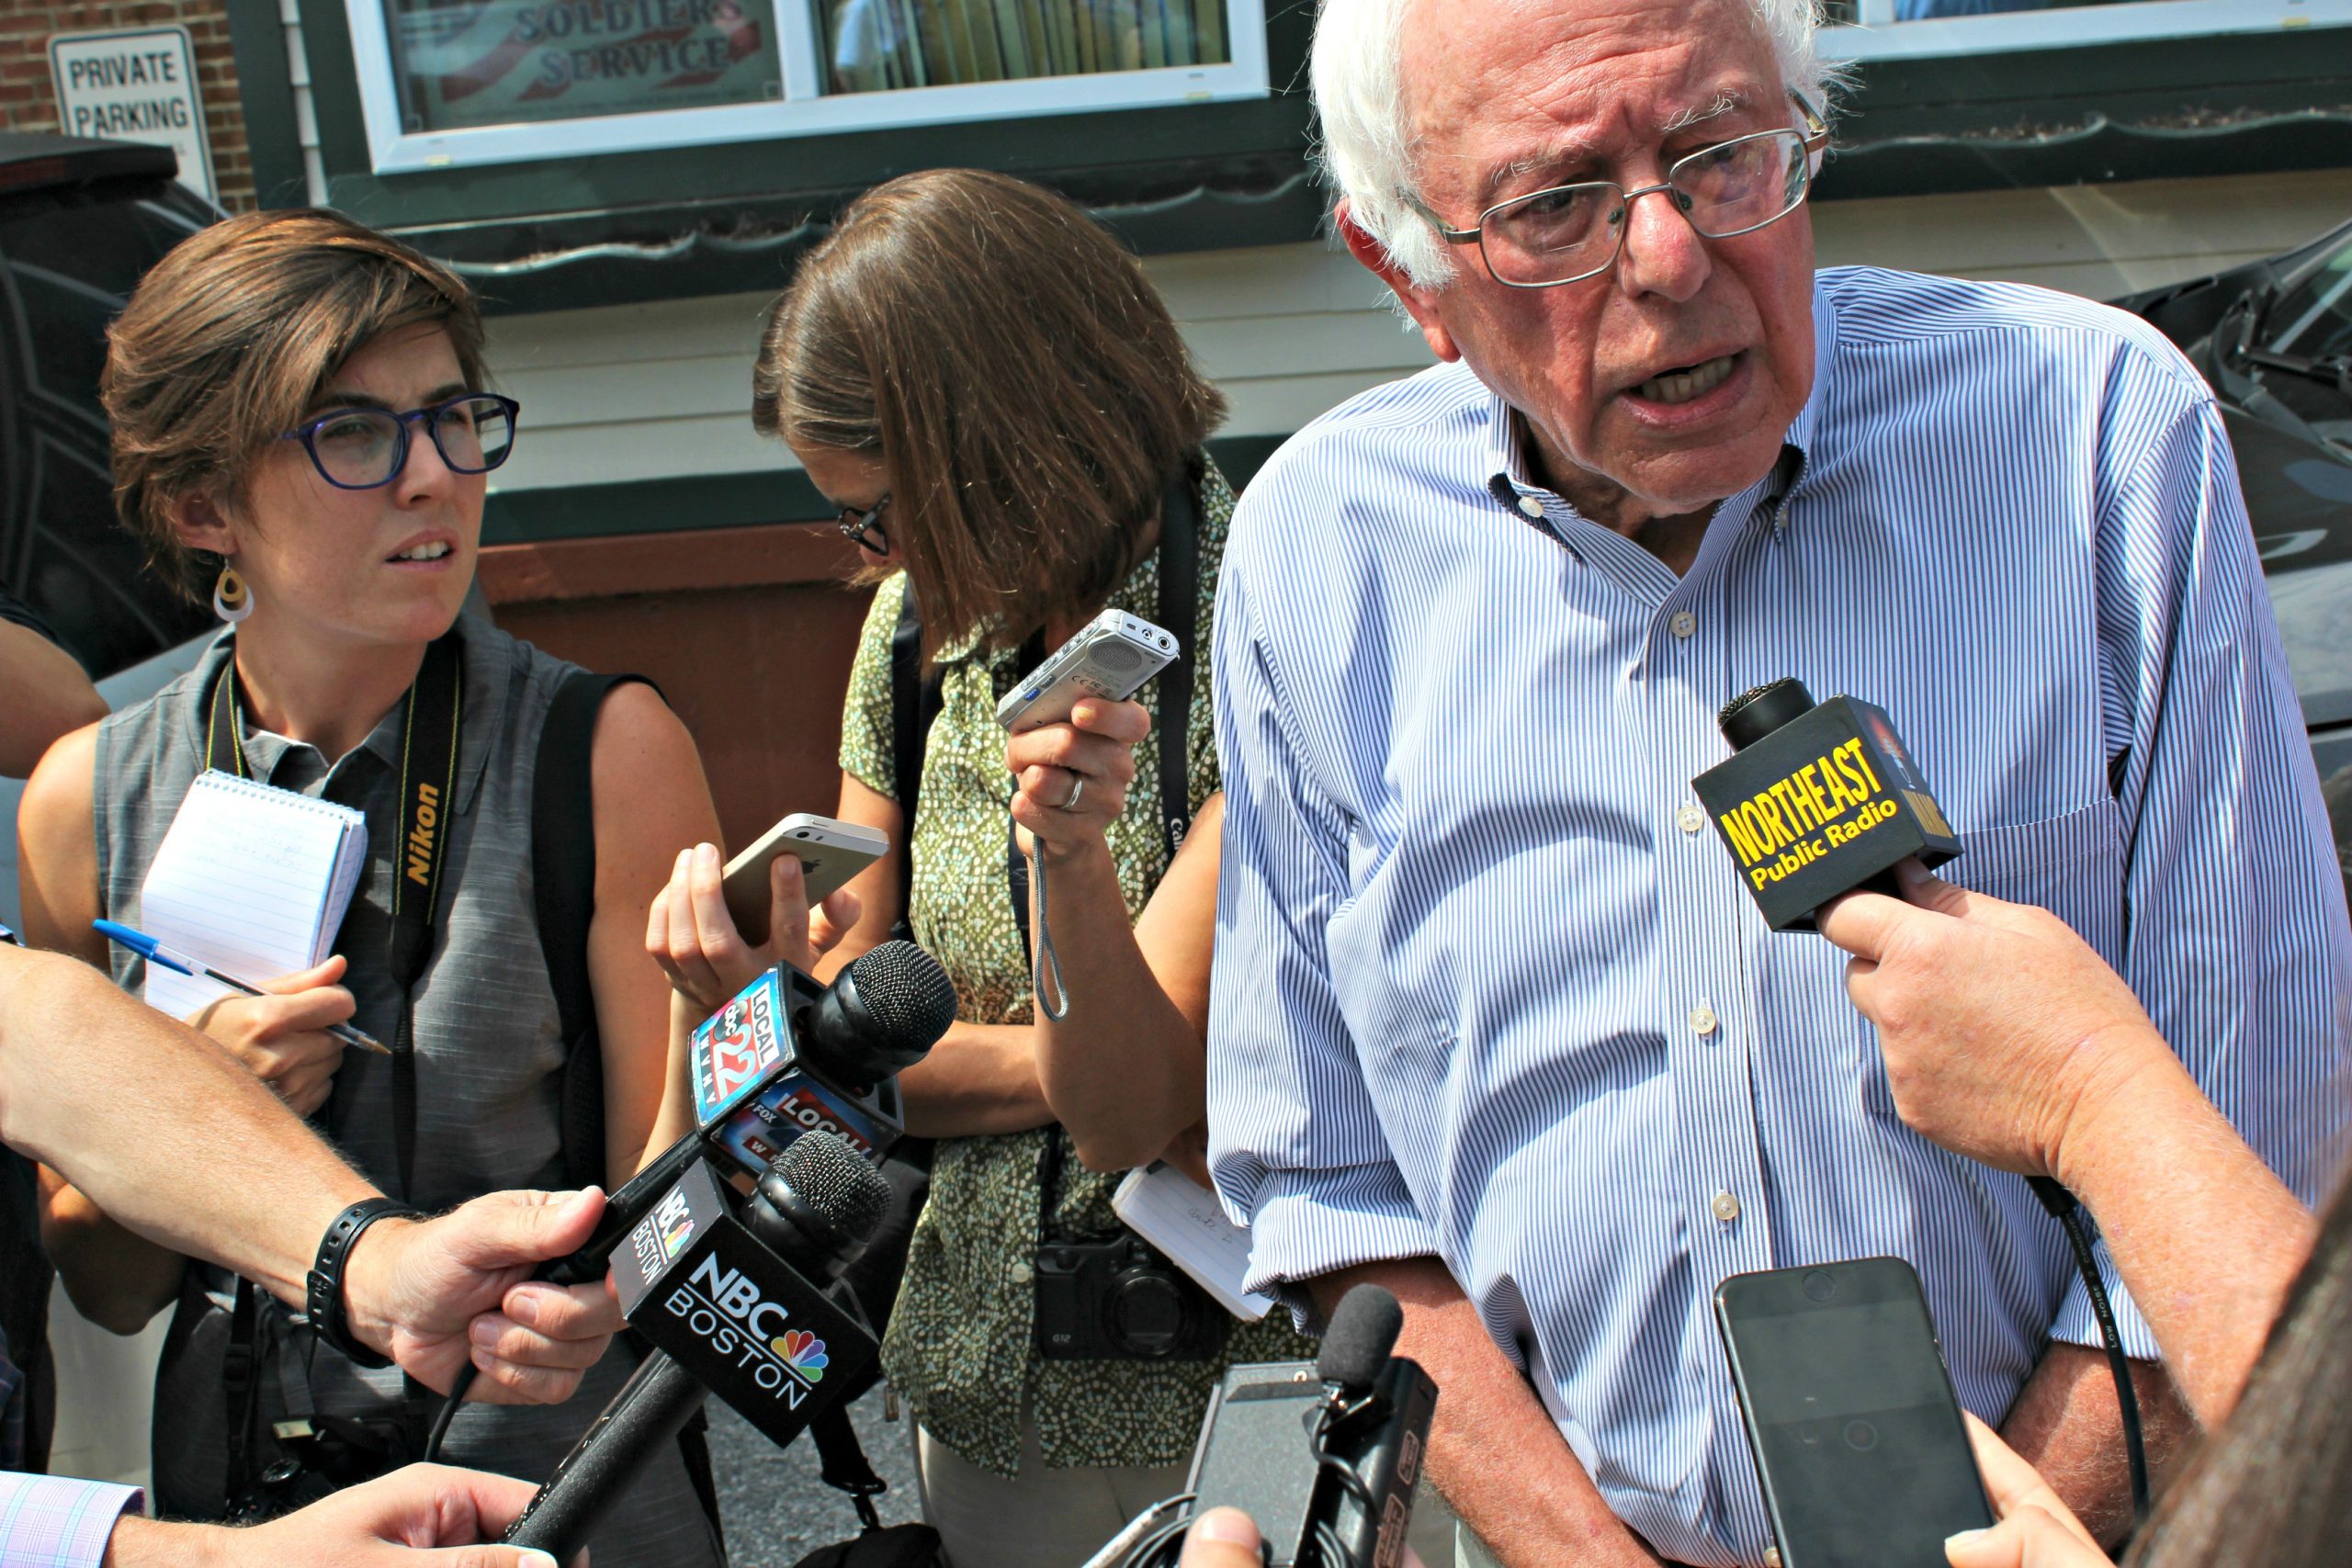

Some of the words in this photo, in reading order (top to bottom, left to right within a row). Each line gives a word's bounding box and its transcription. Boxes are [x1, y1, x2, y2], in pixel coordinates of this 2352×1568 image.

[69, 51, 176, 89] PRIVATE
[540, 36, 729, 85] SERVICE
[74, 96, 188, 137] PARKING
[1720, 737, 1882, 868] NORTHEAST
[407, 783, 439, 886] Nikon
[1749, 838, 1828, 891] Public
[1825, 798, 1897, 849] Radio
[724, 1003, 741, 1037] abc
[752, 988, 775, 1064] LOCAL
[713, 1022, 756, 1102] 22
[752, 1104, 777, 1123] FOX
[655, 1185, 690, 1239] NBC
[632, 1220, 662, 1285] BOSTON
[689, 1251, 788, 1342] NBC
[2093, 1285, 2109, 1317] NOISE
[663, 1288, 808, 1411] BOSTON
[2105, 1324, 2118, 1348] LOW
